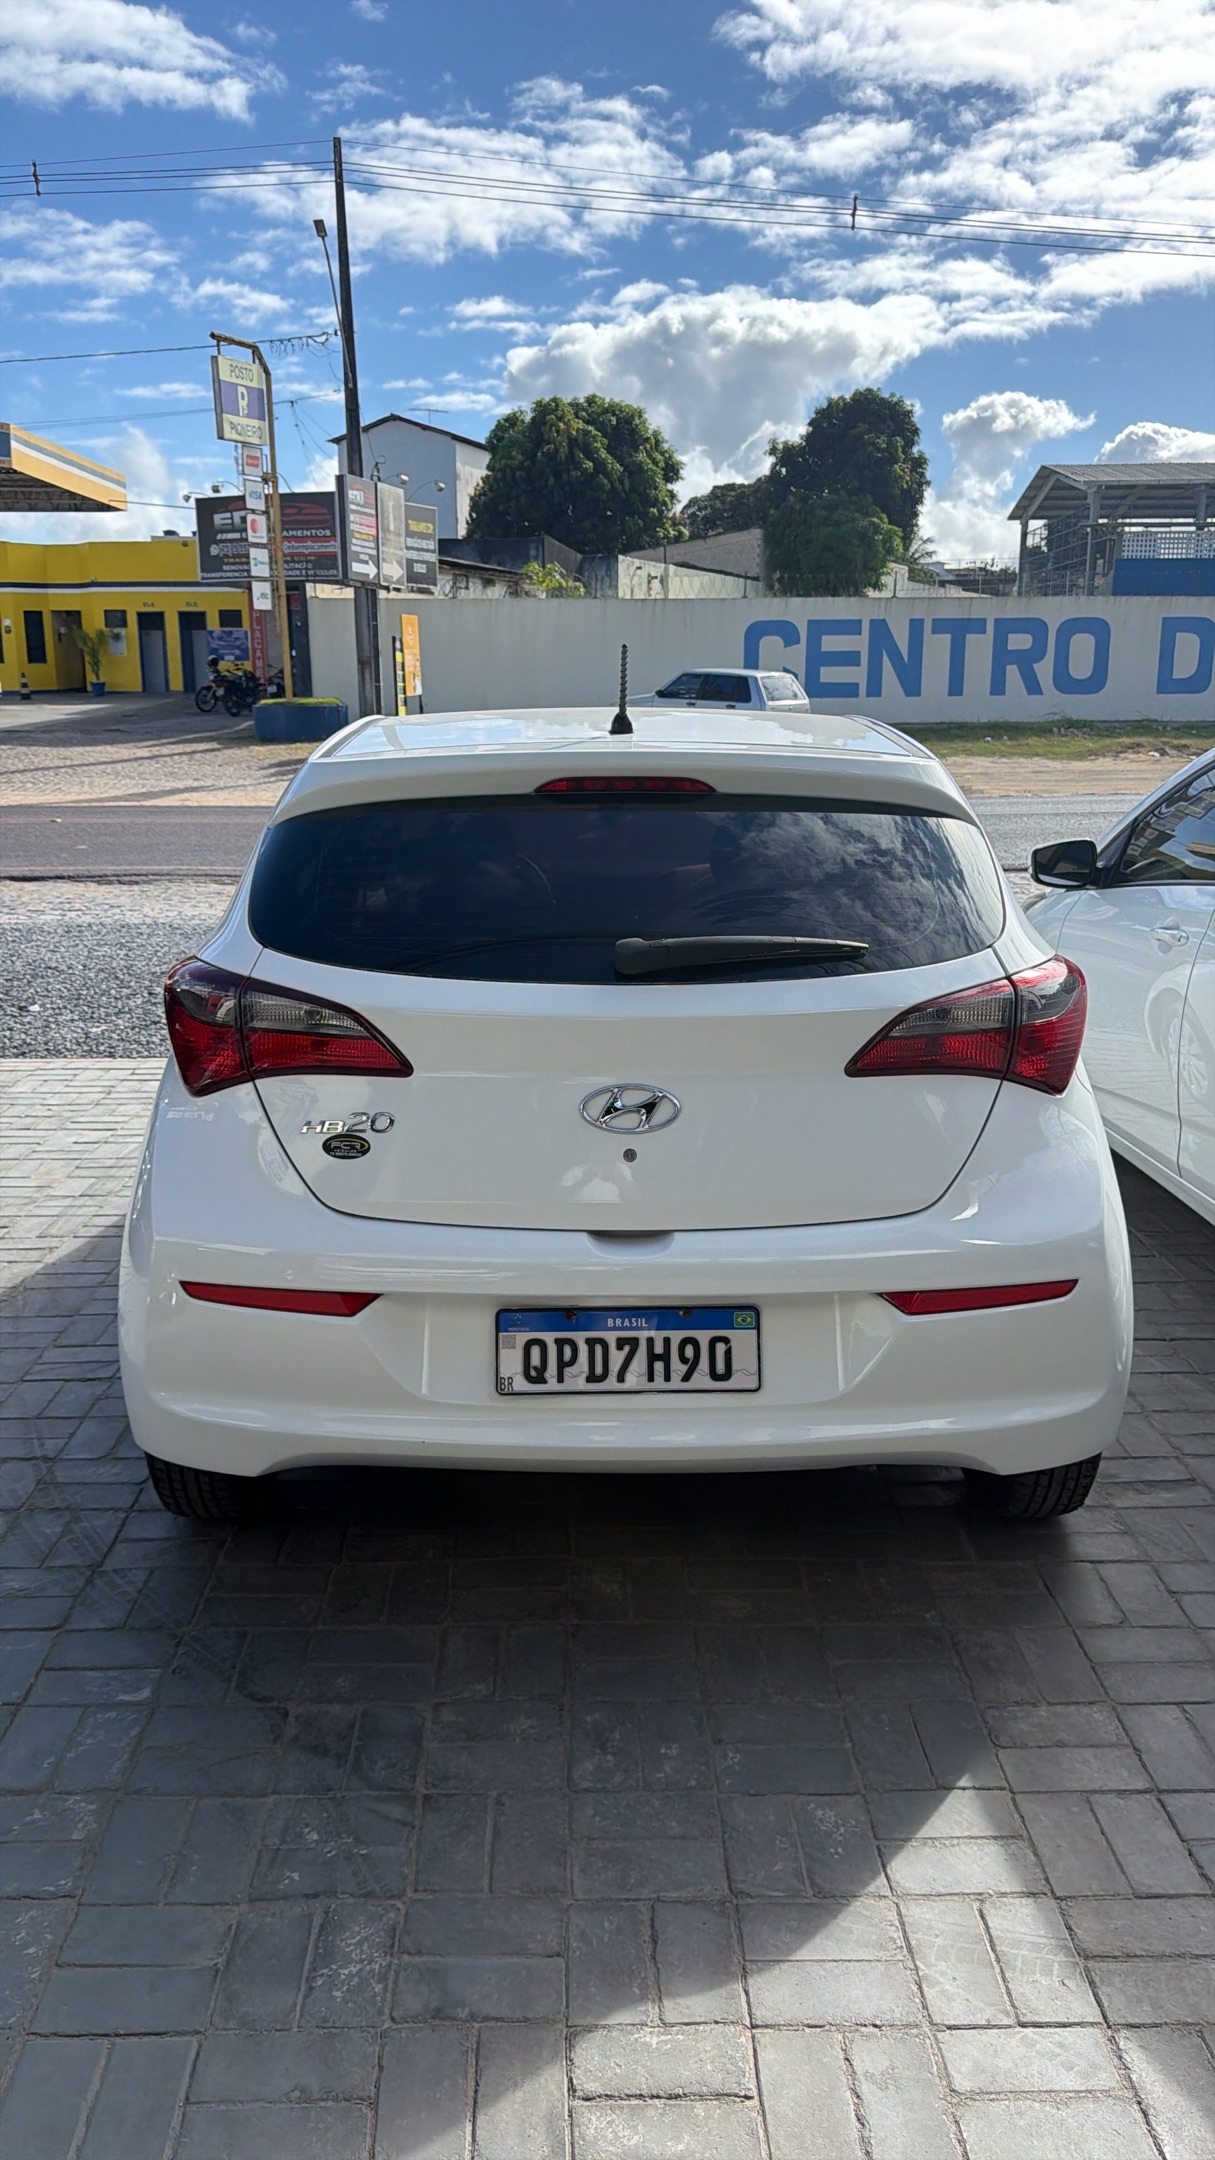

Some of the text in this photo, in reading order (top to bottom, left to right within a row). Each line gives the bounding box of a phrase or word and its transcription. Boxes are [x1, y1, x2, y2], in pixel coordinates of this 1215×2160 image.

[229, 364, 254, 382] POSTO
[229, 421, 263, 440] PIONEIRO
[249, 490, 262, 500] VISA
[743, 616, 1111, 698] CENTRO
[300, 1111, 395, 1134] HB20
[330, 1141, 361, 1150] FCR
[606, 1316, 649, 1328] BRASIL
[522, 1335, 733, 1385] QPD7H90
[499, 1376, 515, 1392] BR
